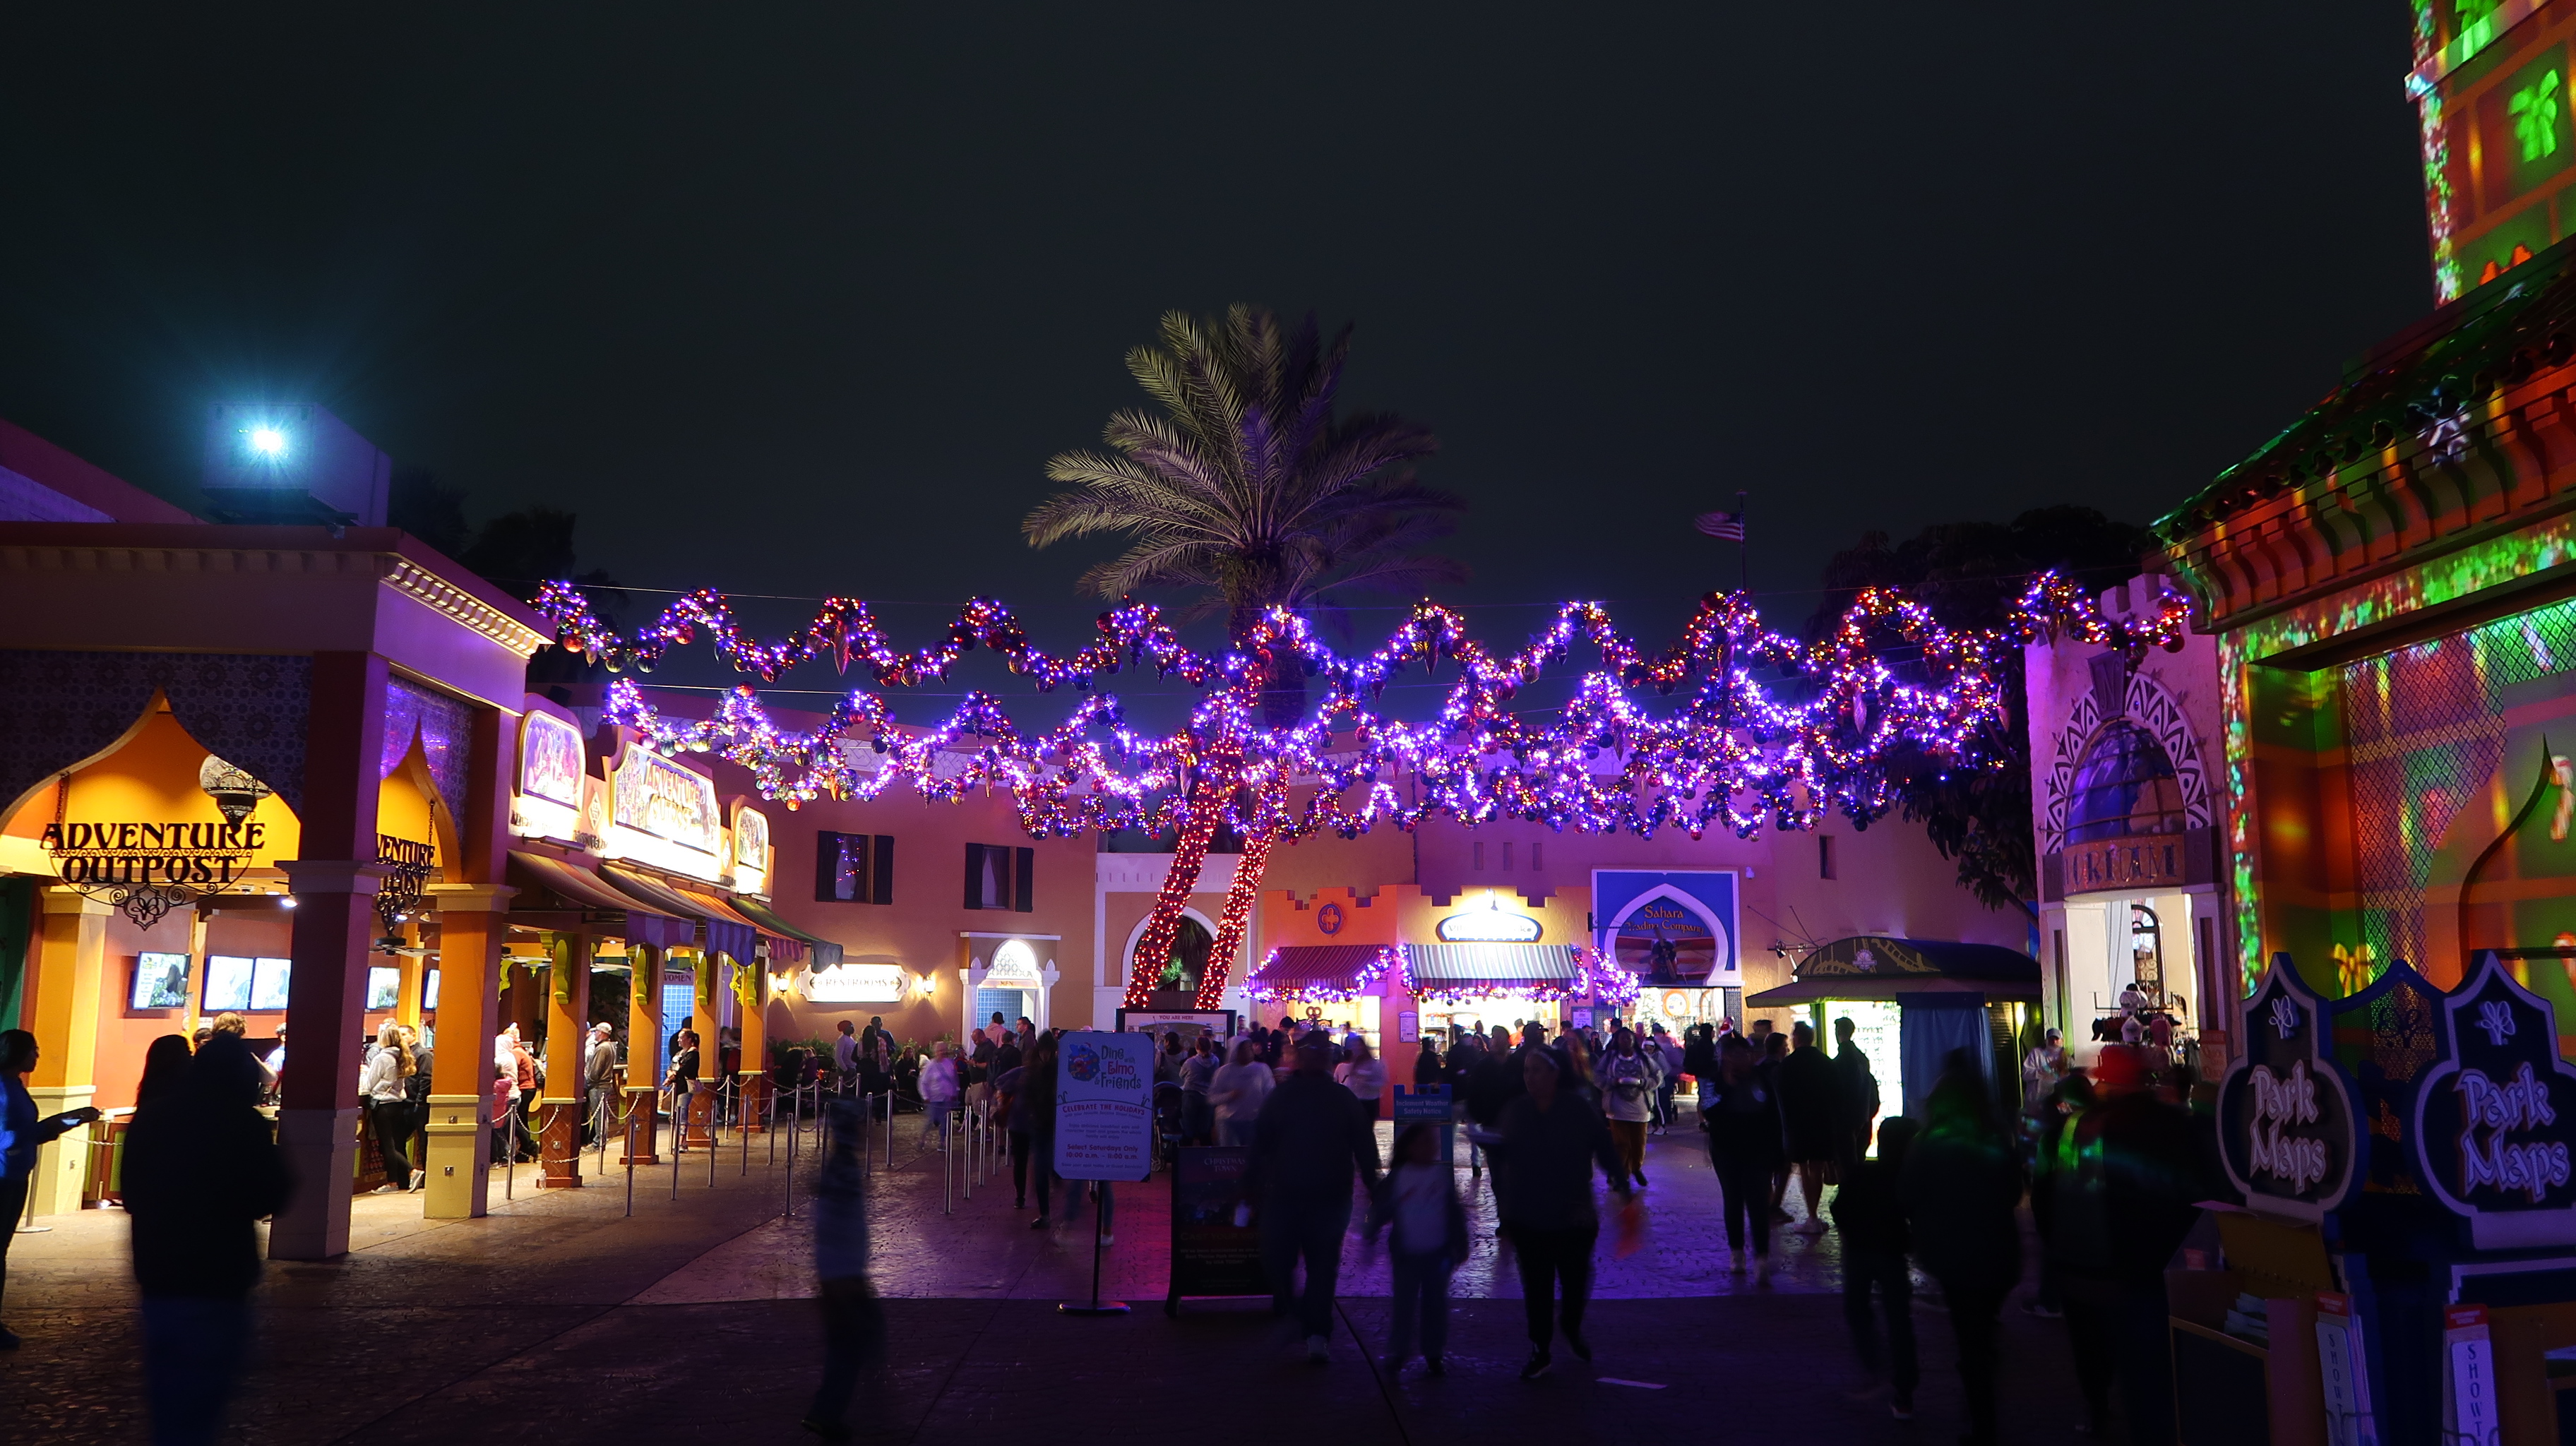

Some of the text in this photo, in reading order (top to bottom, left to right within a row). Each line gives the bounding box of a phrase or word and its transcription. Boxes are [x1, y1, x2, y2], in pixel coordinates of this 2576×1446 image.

[39, 823, 266, 849] ADVENTURE
[376, 833, 435, 868] VENTURE
[62, 855, 238, 883] OUTPOST
[1644, 905, 1684, 919] Sahara
[1662, 920, 1705, 936] Company
[825, 979, 887, 987] RESTROOMS
[1102, 1046, 1123, 1059] Dine
[1100, 1072, 1141, 1089] Friends
[1107, 1061, 1135, 1075] Elmo
[2247, 1058, 2320, 1126] Park
[2453, 1060, 2558, 1131] Park
[1062, 1104, 1097, 1113] CELEBRATE
[1114, 1104, 1145, 1116] HOLIDAYS
[2250, 1116, 2326, 1195] Maps
[2460, 1132, 2570, 1204] Maps
[2468, 1344, 2483, 1446] SHOWT
